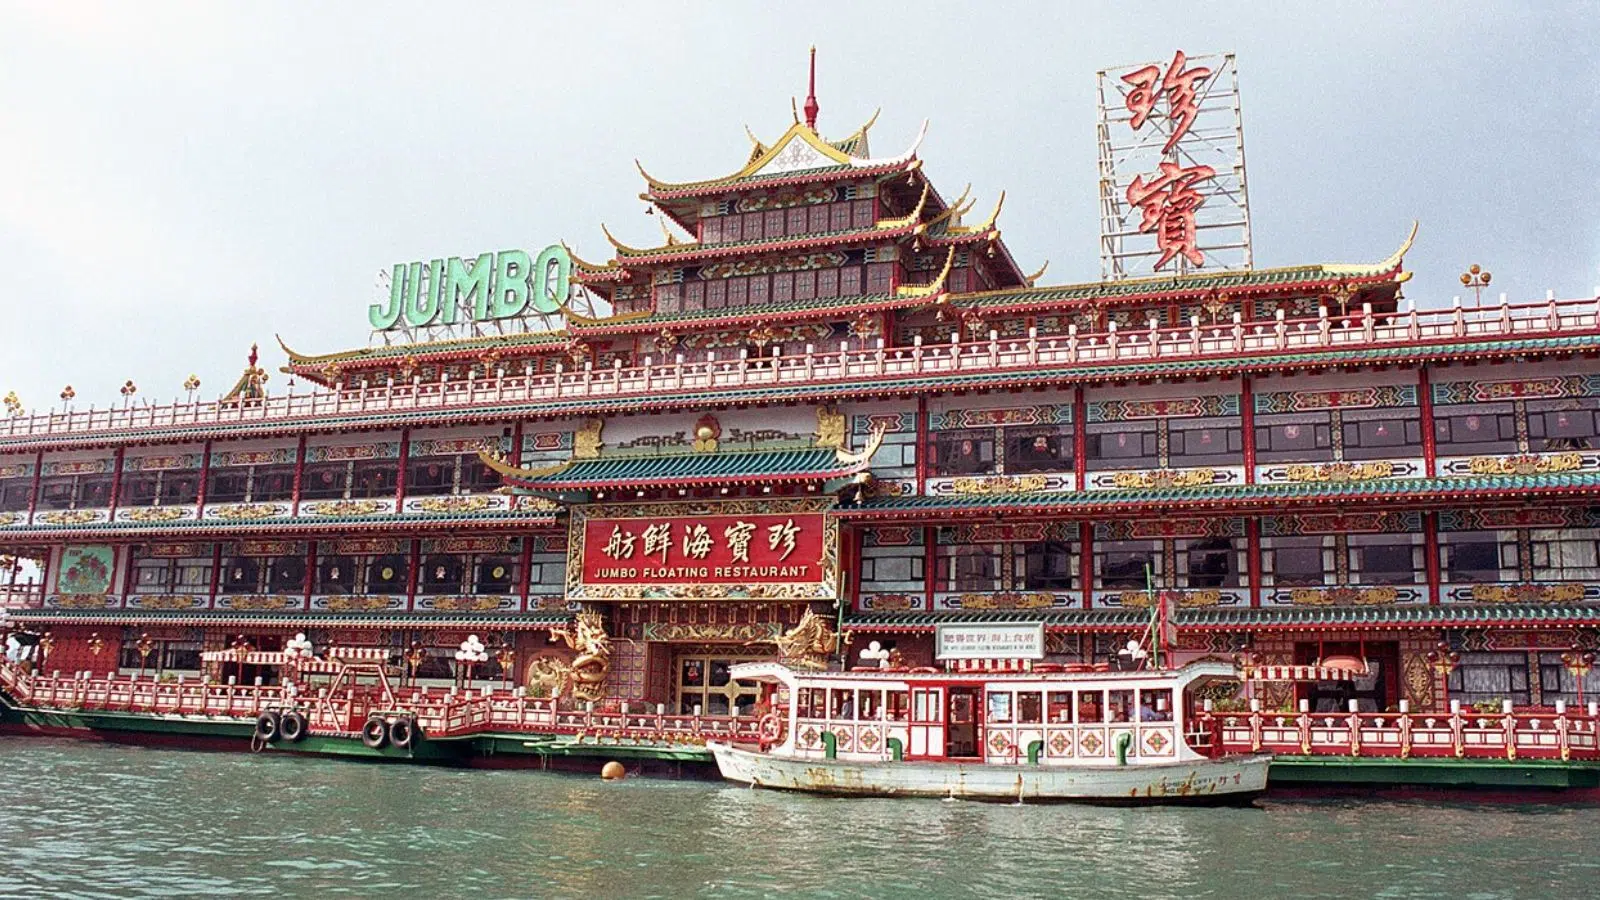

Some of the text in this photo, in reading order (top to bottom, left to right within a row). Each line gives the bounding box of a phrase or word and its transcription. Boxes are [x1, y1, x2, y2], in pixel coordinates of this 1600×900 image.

[1120, 50, 1216, 272] 珍寶
[368, 244, 572, 330] JUMBO
[594, 566, 808, 578] JUMBO FLOATING RESTAURANT
